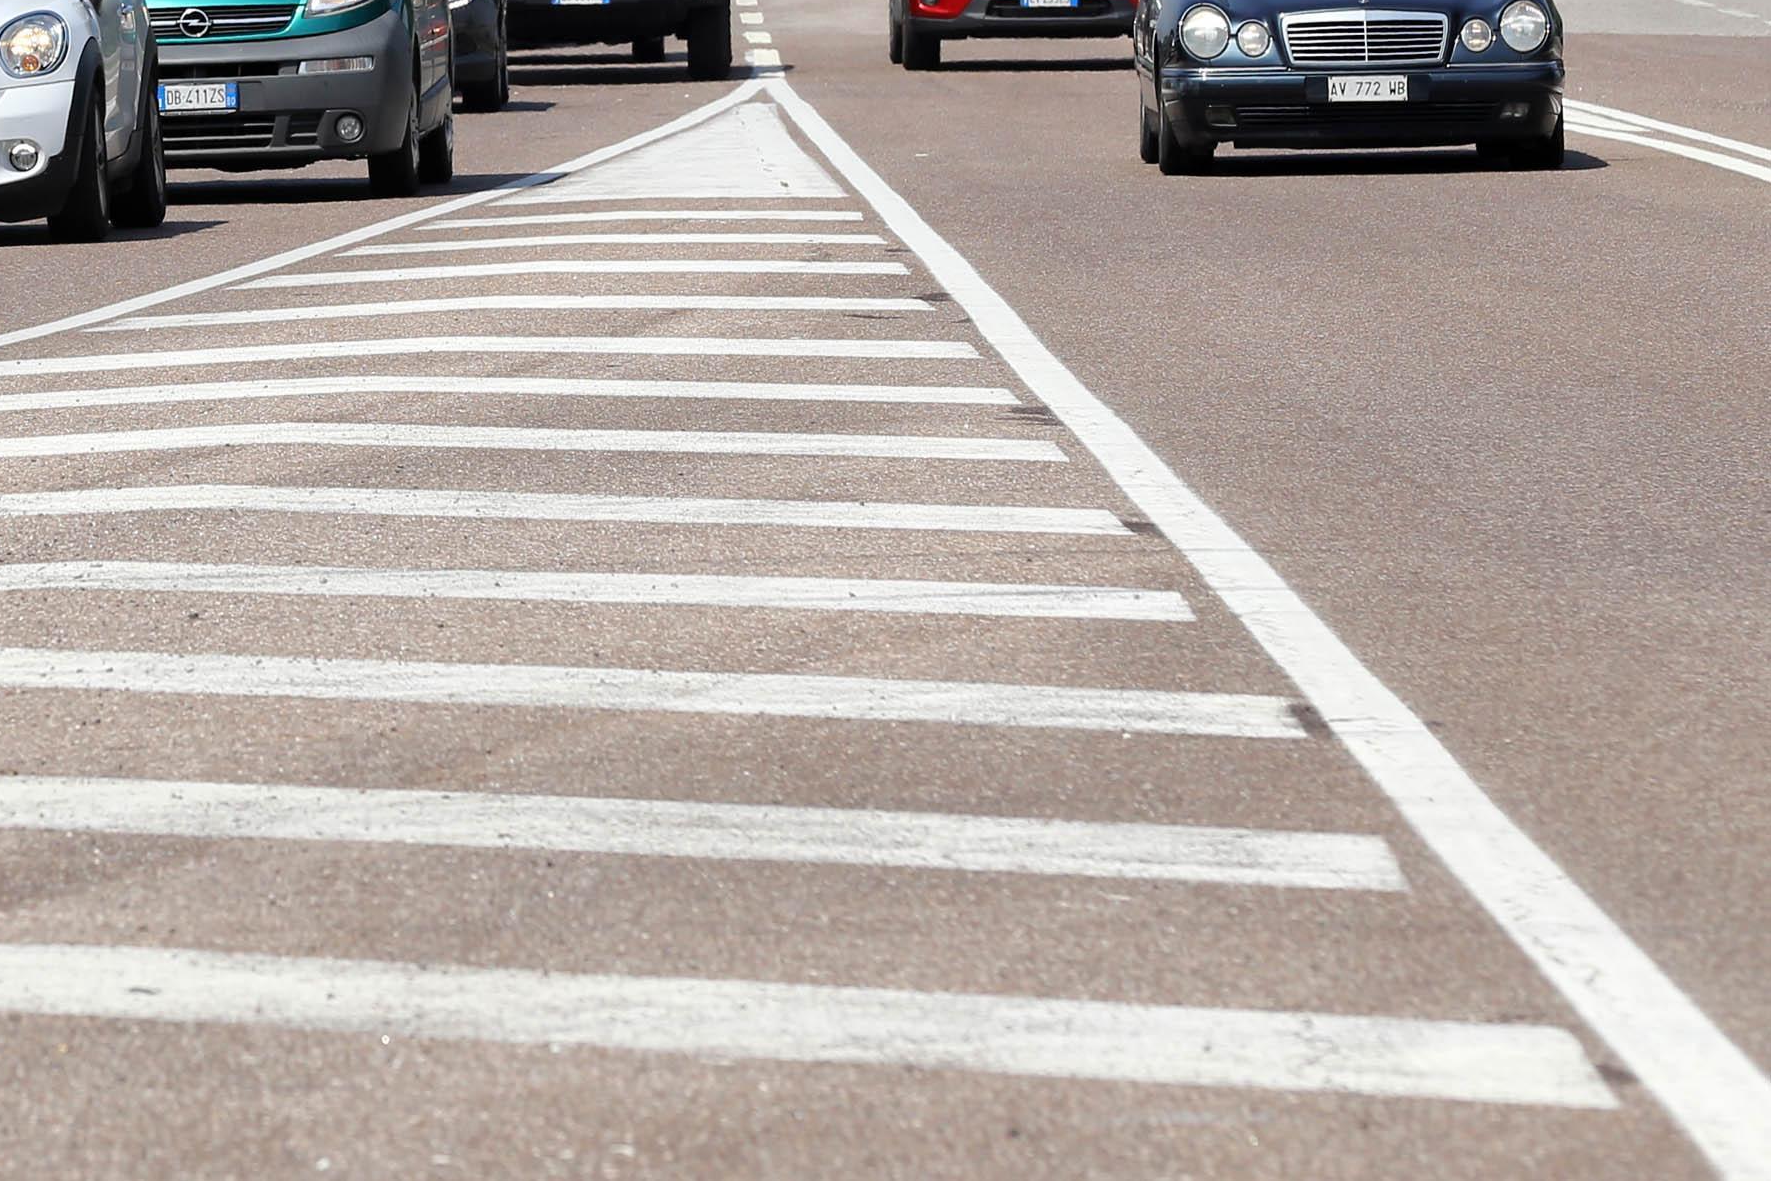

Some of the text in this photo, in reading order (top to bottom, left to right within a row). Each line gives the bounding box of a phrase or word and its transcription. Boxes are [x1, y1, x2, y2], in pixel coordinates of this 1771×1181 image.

[1330, 81, 1406, 97] AV 772 WB
